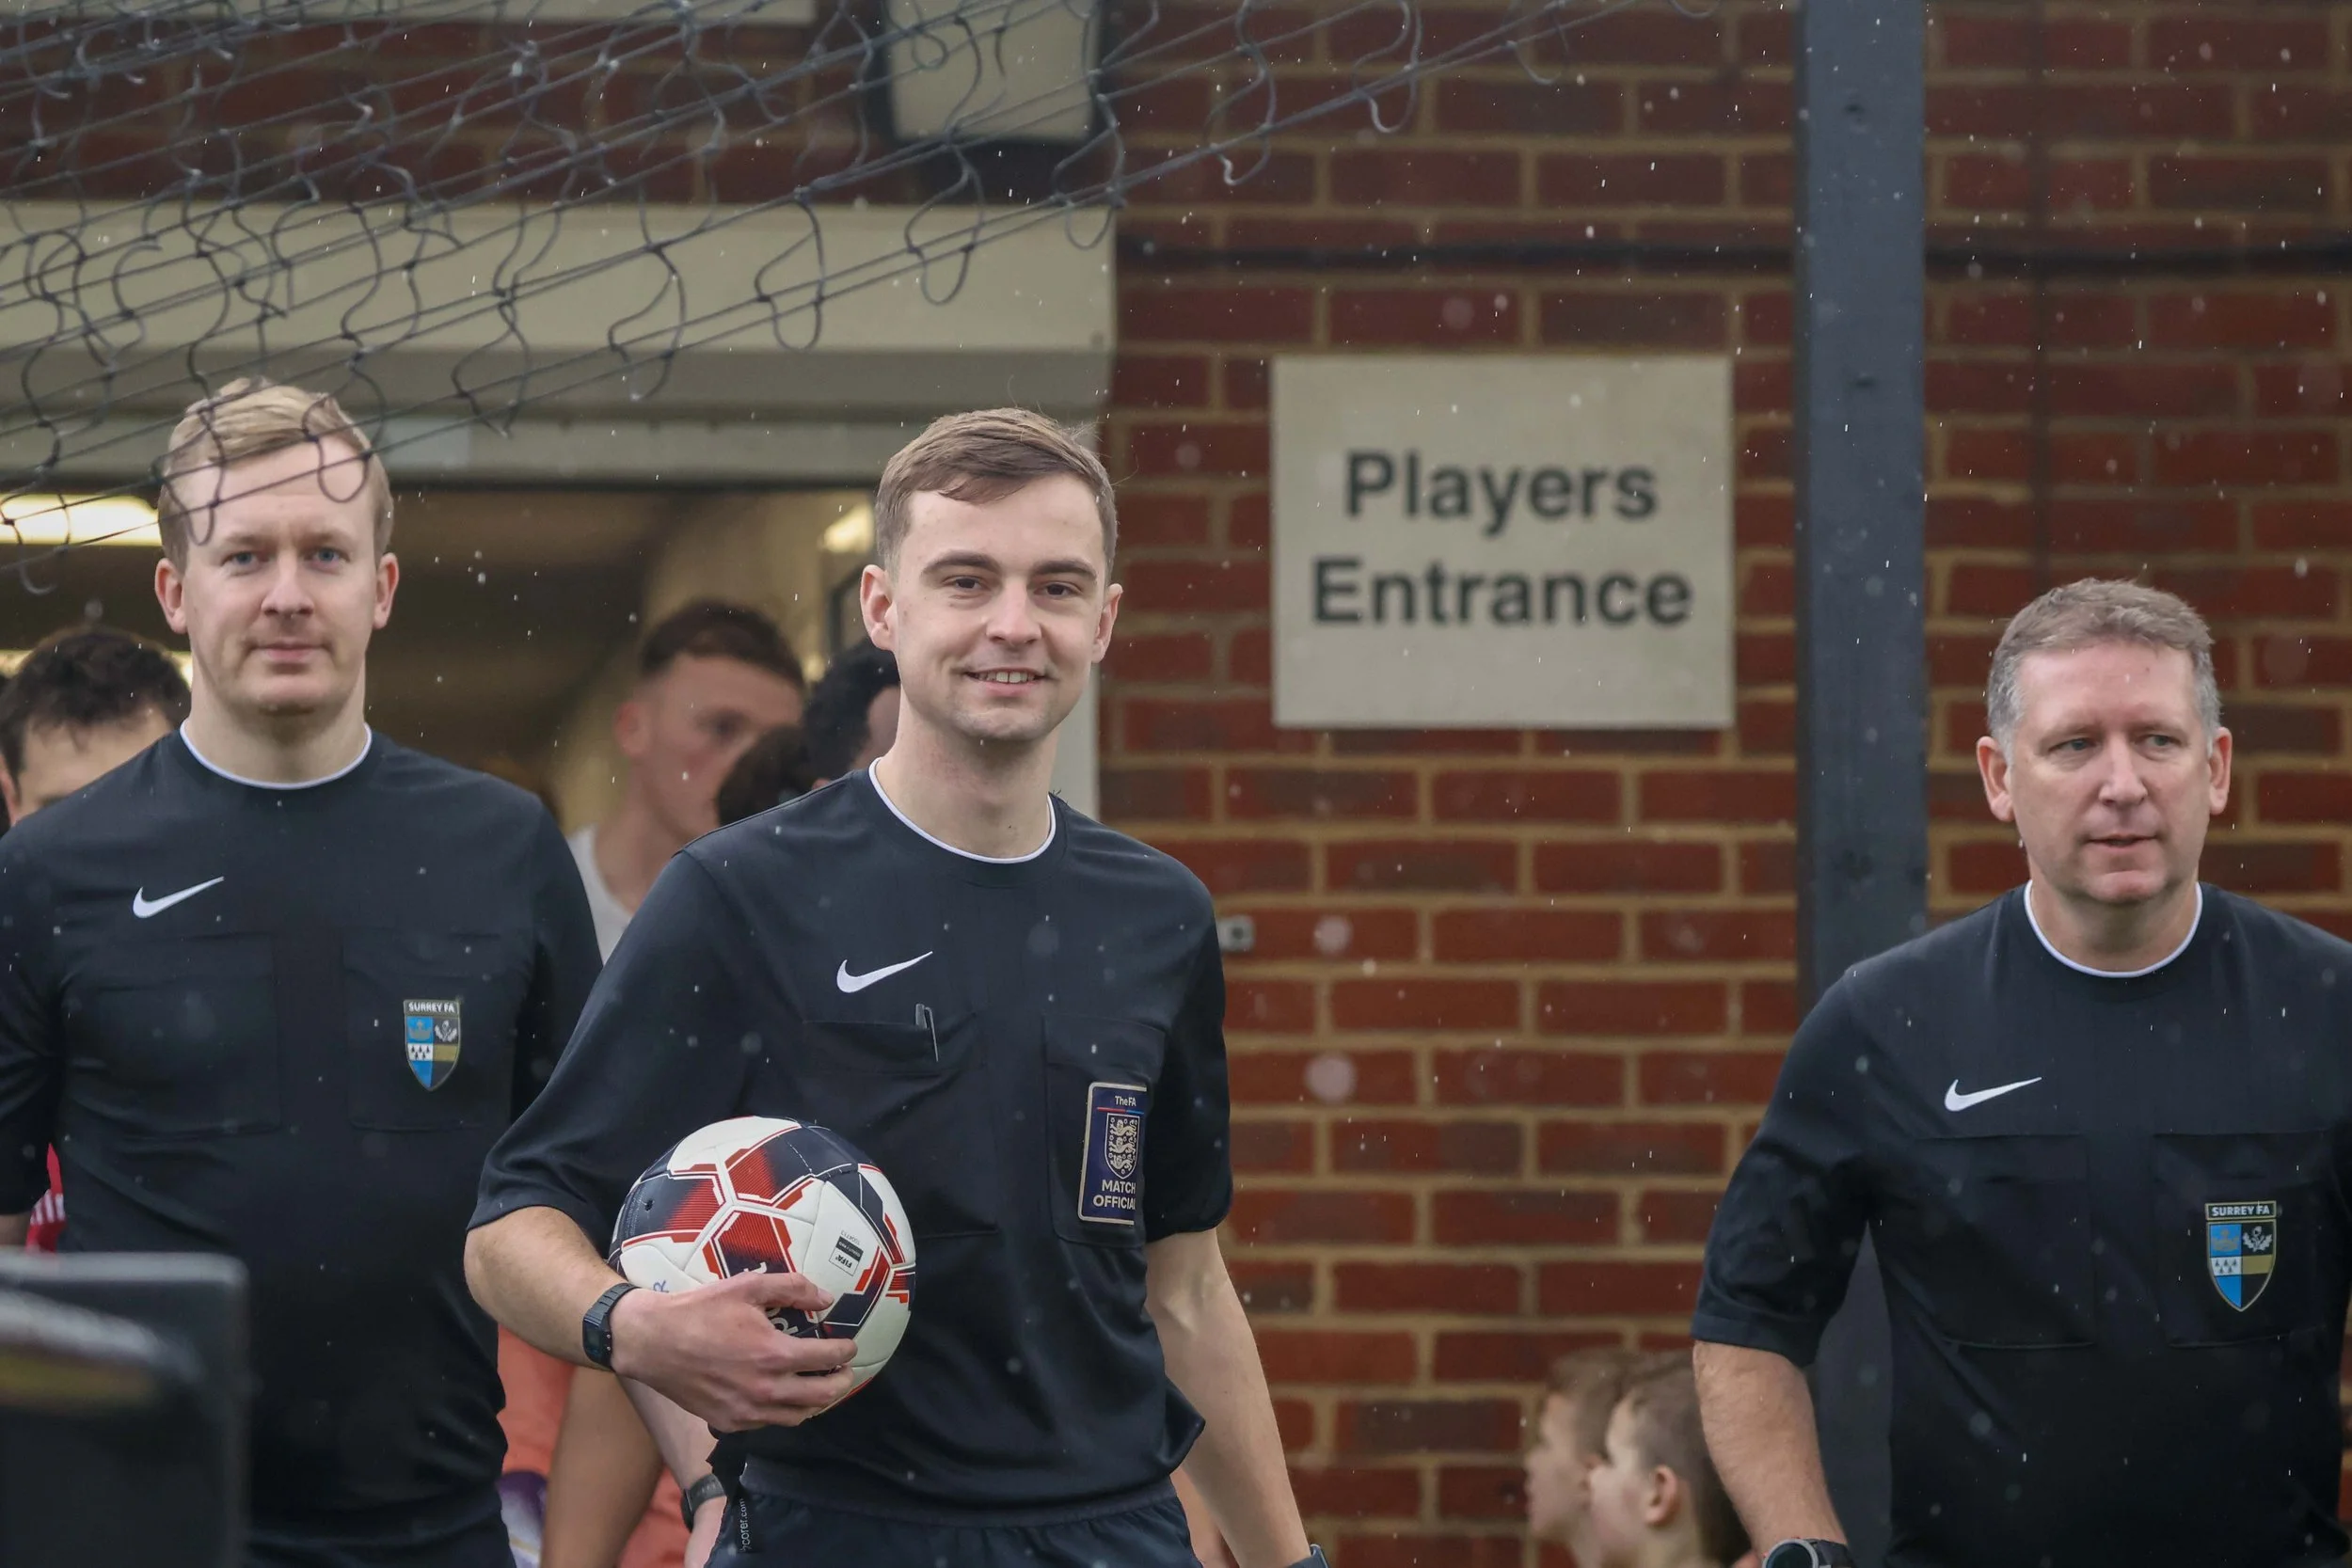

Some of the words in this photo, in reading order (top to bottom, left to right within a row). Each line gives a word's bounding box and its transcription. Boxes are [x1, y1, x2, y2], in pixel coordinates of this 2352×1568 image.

[1345, 449, 1659, 537] Players
[1312, 556, 1692, 626] Entrance
[408, 1001, 442, 1013] SURREY
[443, 1002, 455, 1013] FA
[1102, 1179, 1136, 1195] MATCH
[2212, 1206, 2255, 1216] SURREY
[2256, 1205, 2270, 1215] FA
